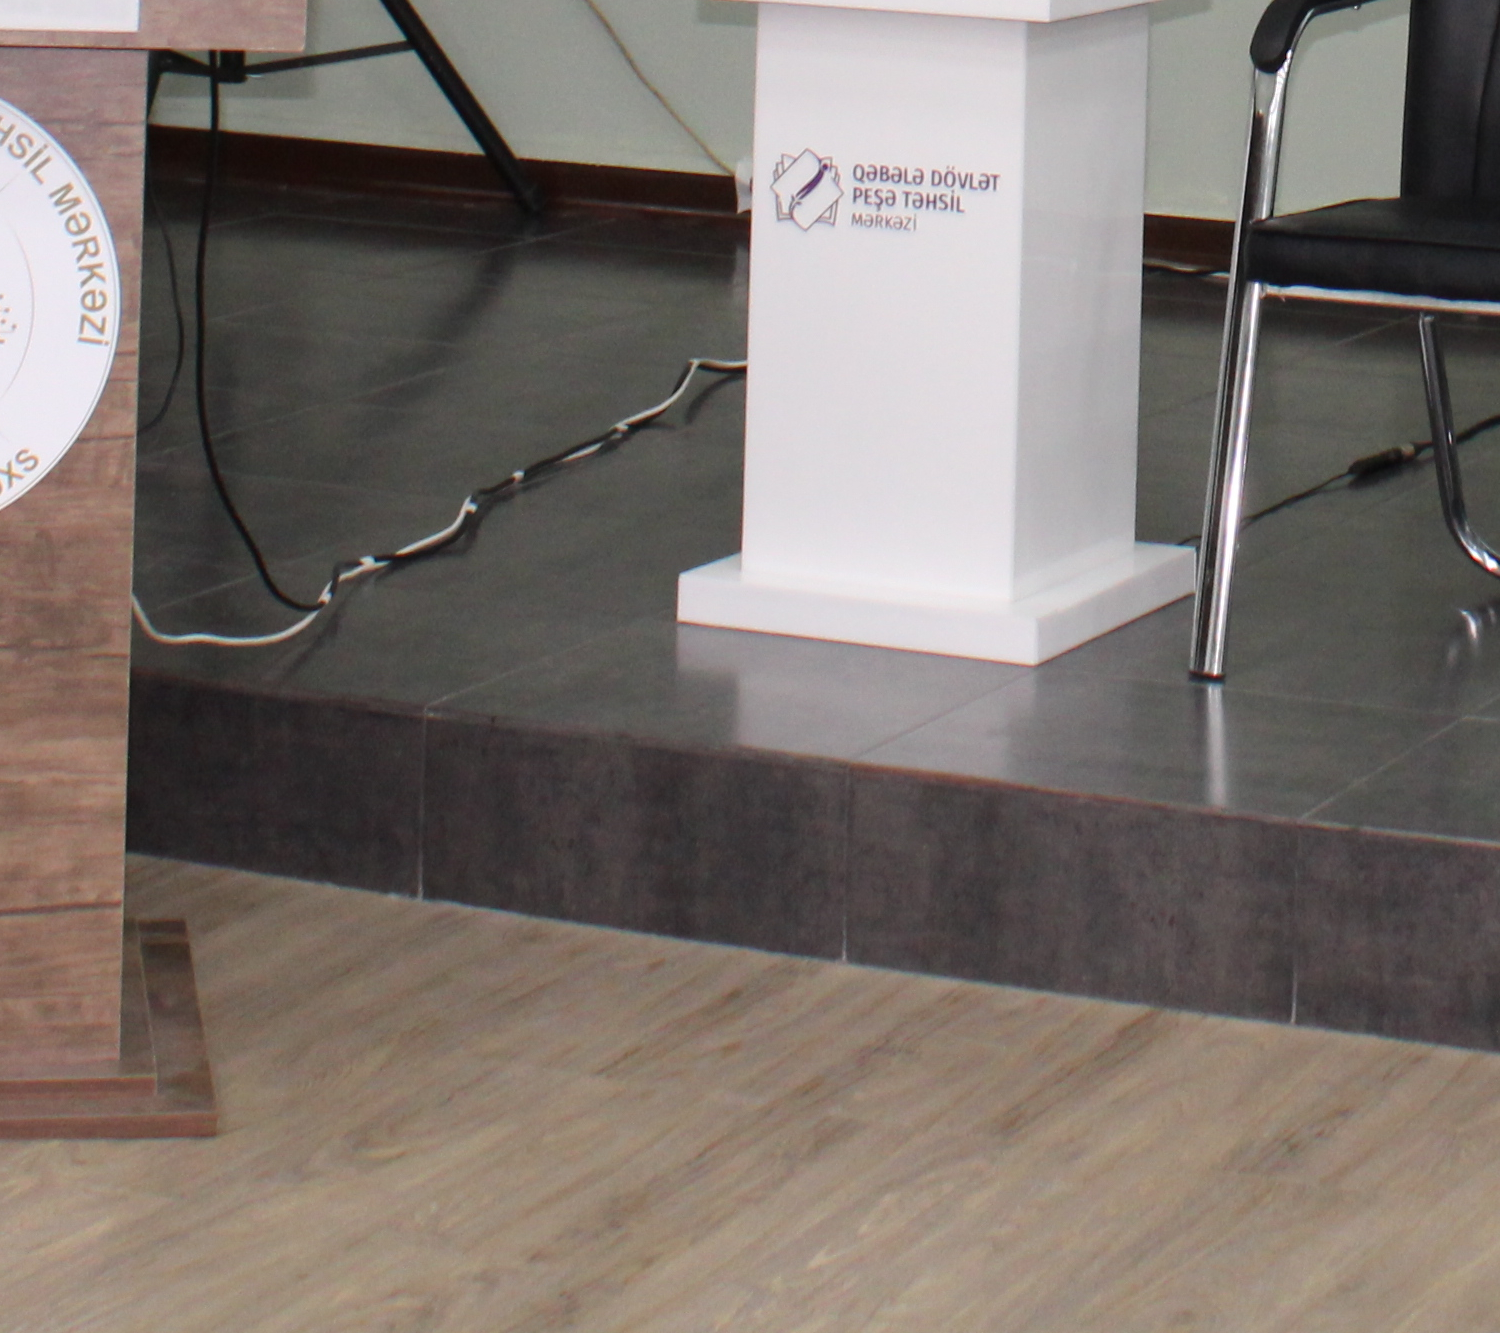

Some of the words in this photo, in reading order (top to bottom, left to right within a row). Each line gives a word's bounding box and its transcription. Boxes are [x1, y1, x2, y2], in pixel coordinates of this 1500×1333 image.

[852, 163, 925, 186] QƏBƏLƏ
[930, 165, 1001, 192] DÖVLƏT
[852, 186, 897, 212] PEŞƏ
[901, 190, 966, 213] TƏHSİL
[850, 212, 918, 232] MƏRKƏZİ
[48, 181, 110, 348] MƏRKƏZİ
